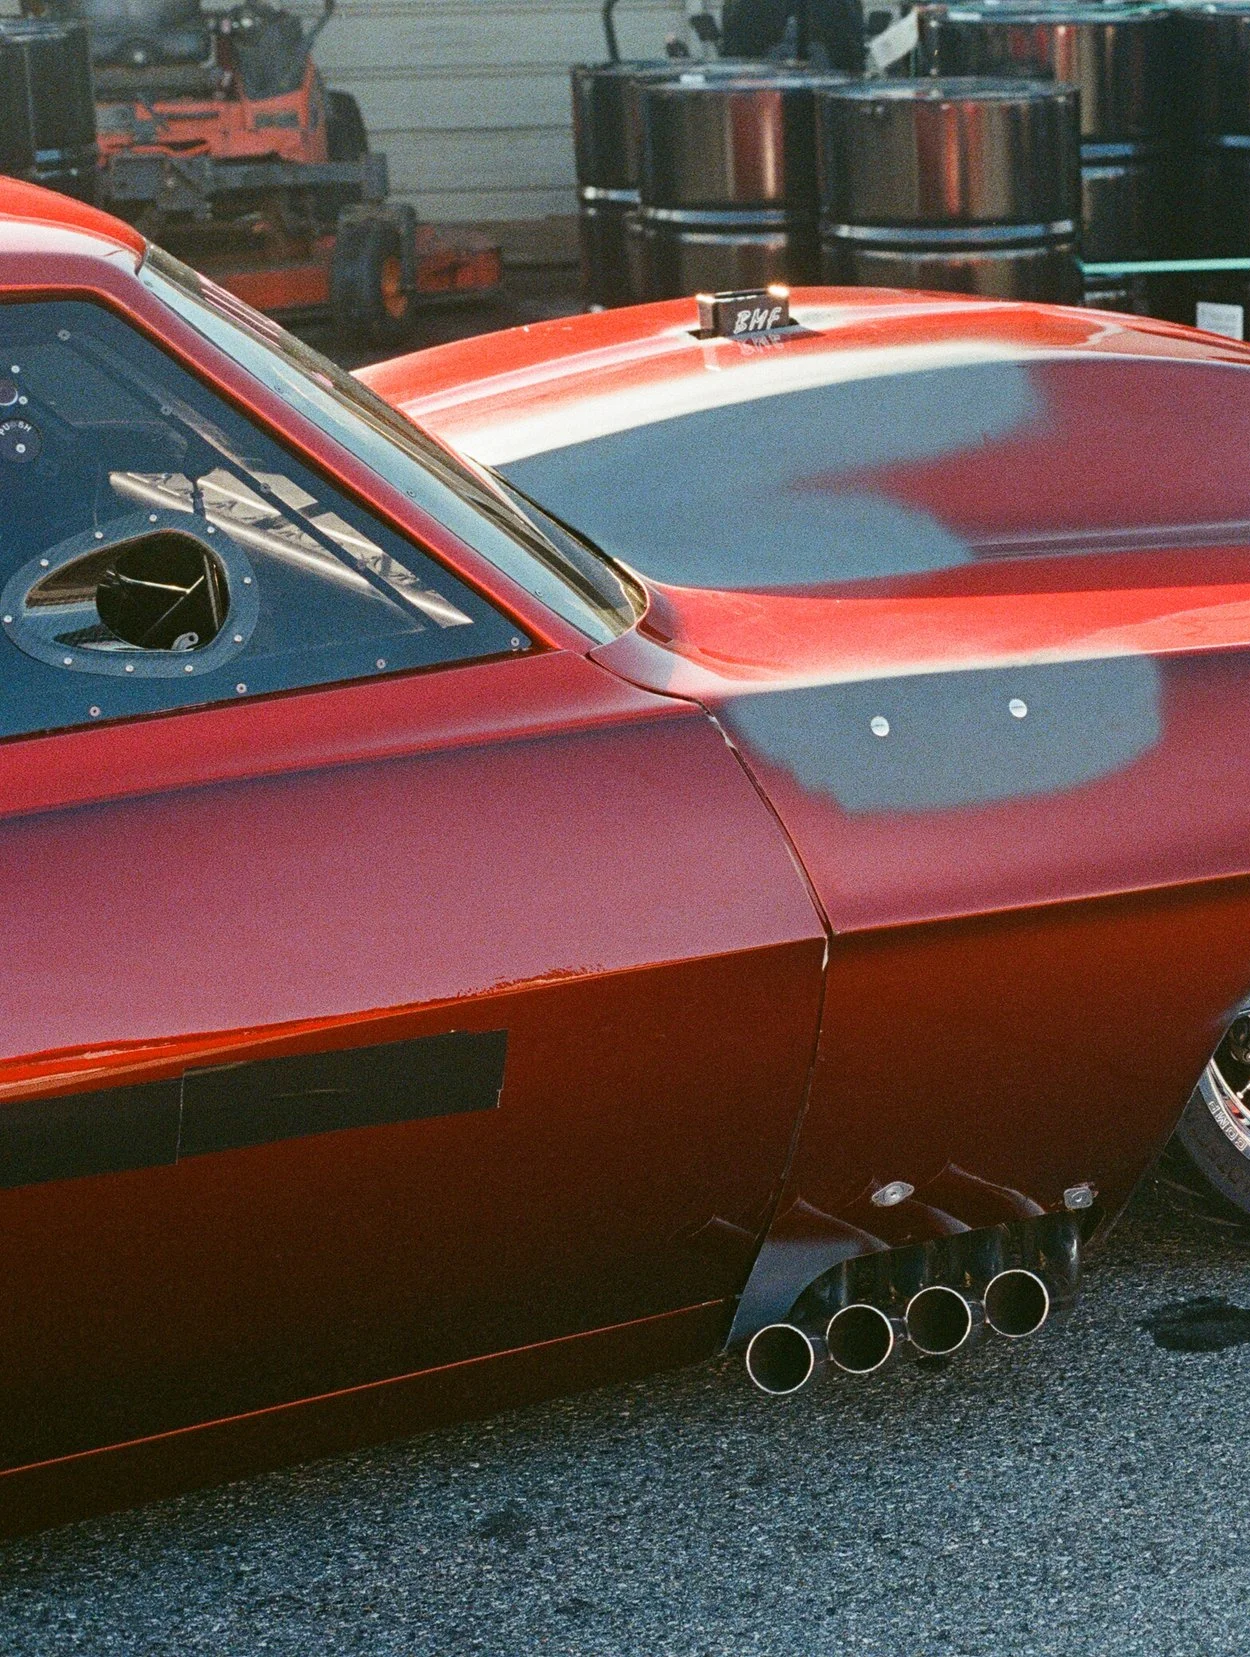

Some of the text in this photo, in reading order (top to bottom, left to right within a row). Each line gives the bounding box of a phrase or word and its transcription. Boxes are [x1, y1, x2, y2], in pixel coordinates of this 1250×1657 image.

[733, 306, 782, 334] BMF
[0, 421, 31, 436] PUSH
[1209, 1101, 1248, 1151] COMP
